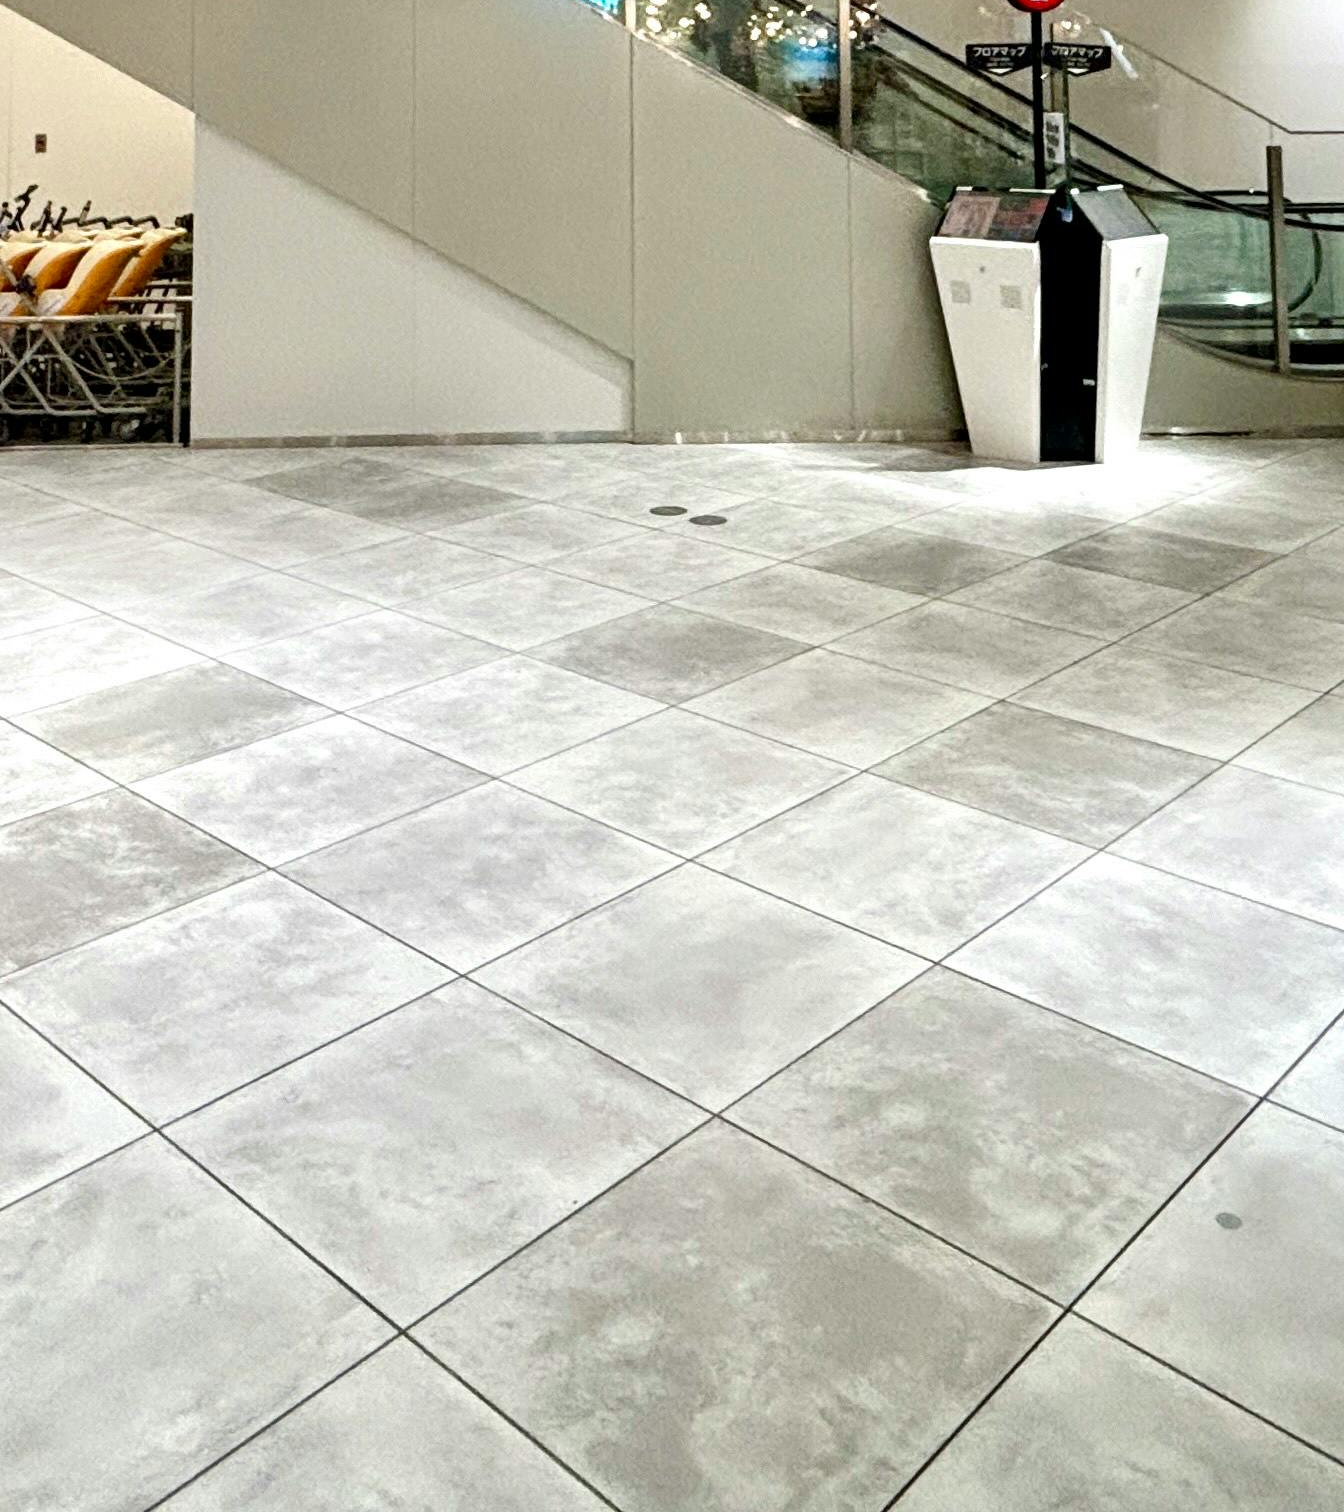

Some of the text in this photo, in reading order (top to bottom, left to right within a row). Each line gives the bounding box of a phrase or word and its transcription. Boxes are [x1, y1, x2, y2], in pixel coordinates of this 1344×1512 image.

[972, 46, 1027, 57] フロアマップ
